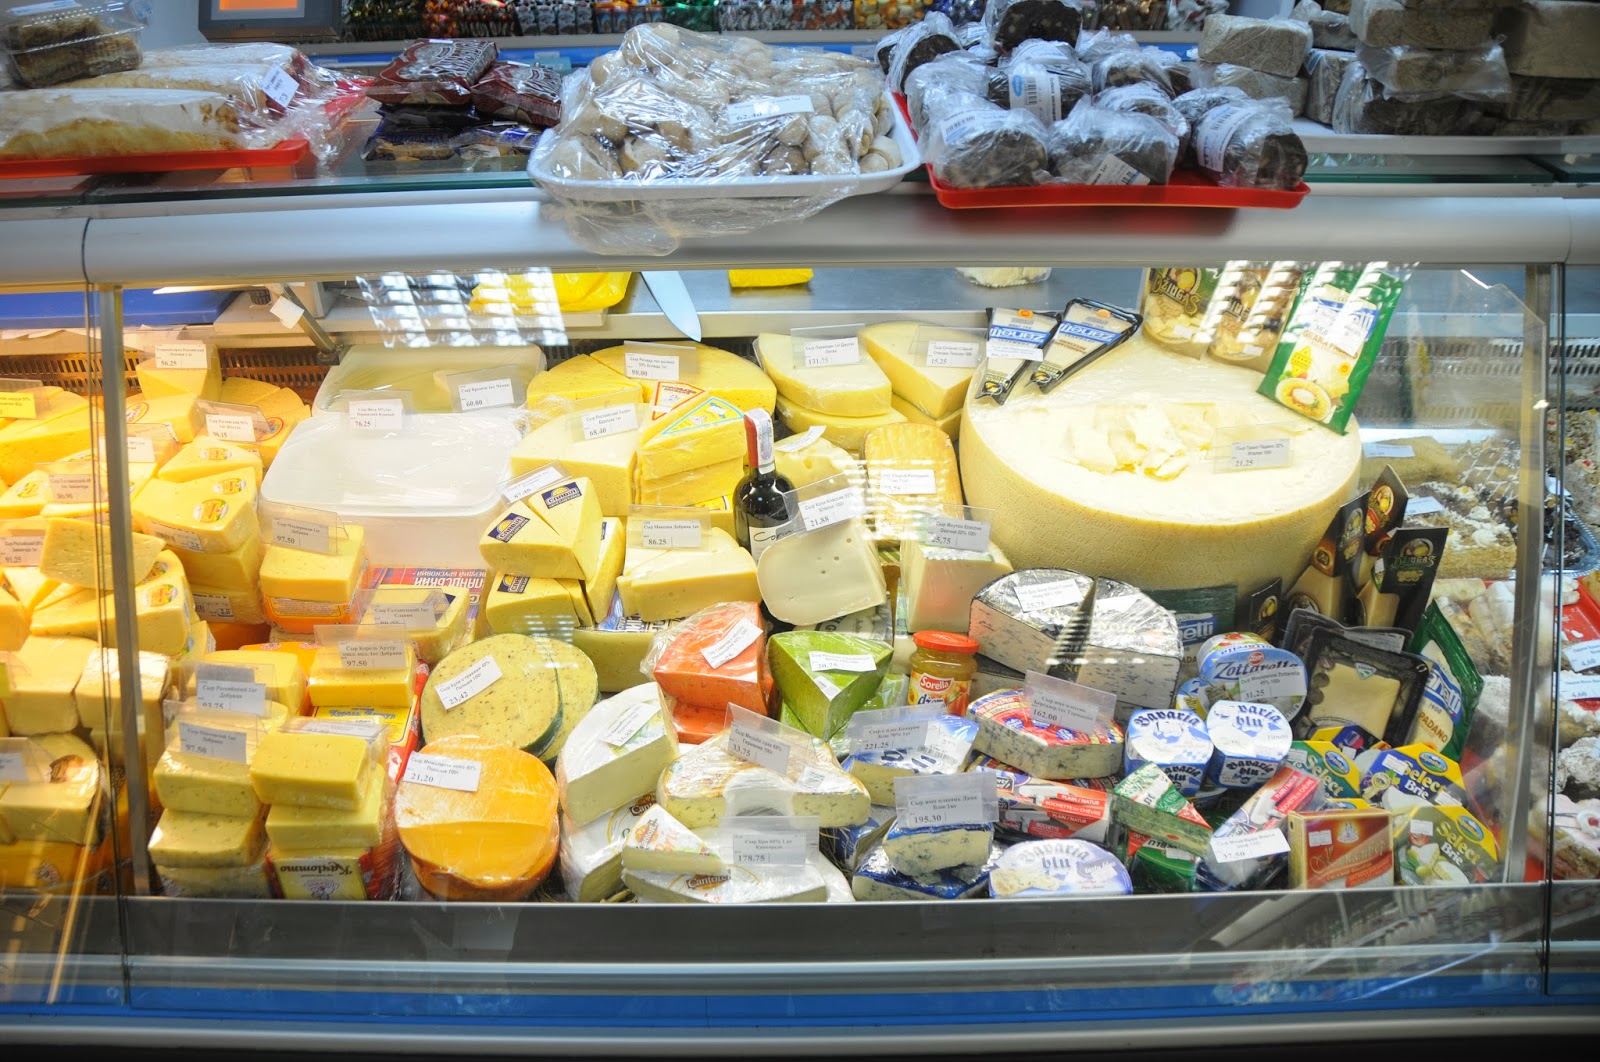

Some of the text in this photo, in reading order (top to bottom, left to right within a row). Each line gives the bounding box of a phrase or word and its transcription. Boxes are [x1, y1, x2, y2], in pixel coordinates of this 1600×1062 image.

[276, 535, 295, 545] 97.50
[920, 675, 950, 691] Sorella
[1033, 709, 1058, 722] 162.00
[1133, 710, 1201, 728] Bavaria
[1235, 715, 1264, 728] blu
[1418, 711, 1448, 744] PADANO
[864, 741, 889, 750] 221.25
[1162, 764, 1201, 779] avaria
[1225, 764, 1274, 779] Bavaria
[1307, 754, 1344, 798] Select
[1403, 760, 1447, 793] Select
[1404, 779, 1429, 800] Brie
[909, 800, 923, 808] Сыр
[1061, 793, 1100, 806] PLAIN NATUR
[914, 815, 942, 824] 195.30
[1436, 820, 1482, 865] Select
[1019, 842, 1091, 864] Bavaria
[1440, 841, 1464, 866] Brie
[1041, 856, 1072, 869] blu
